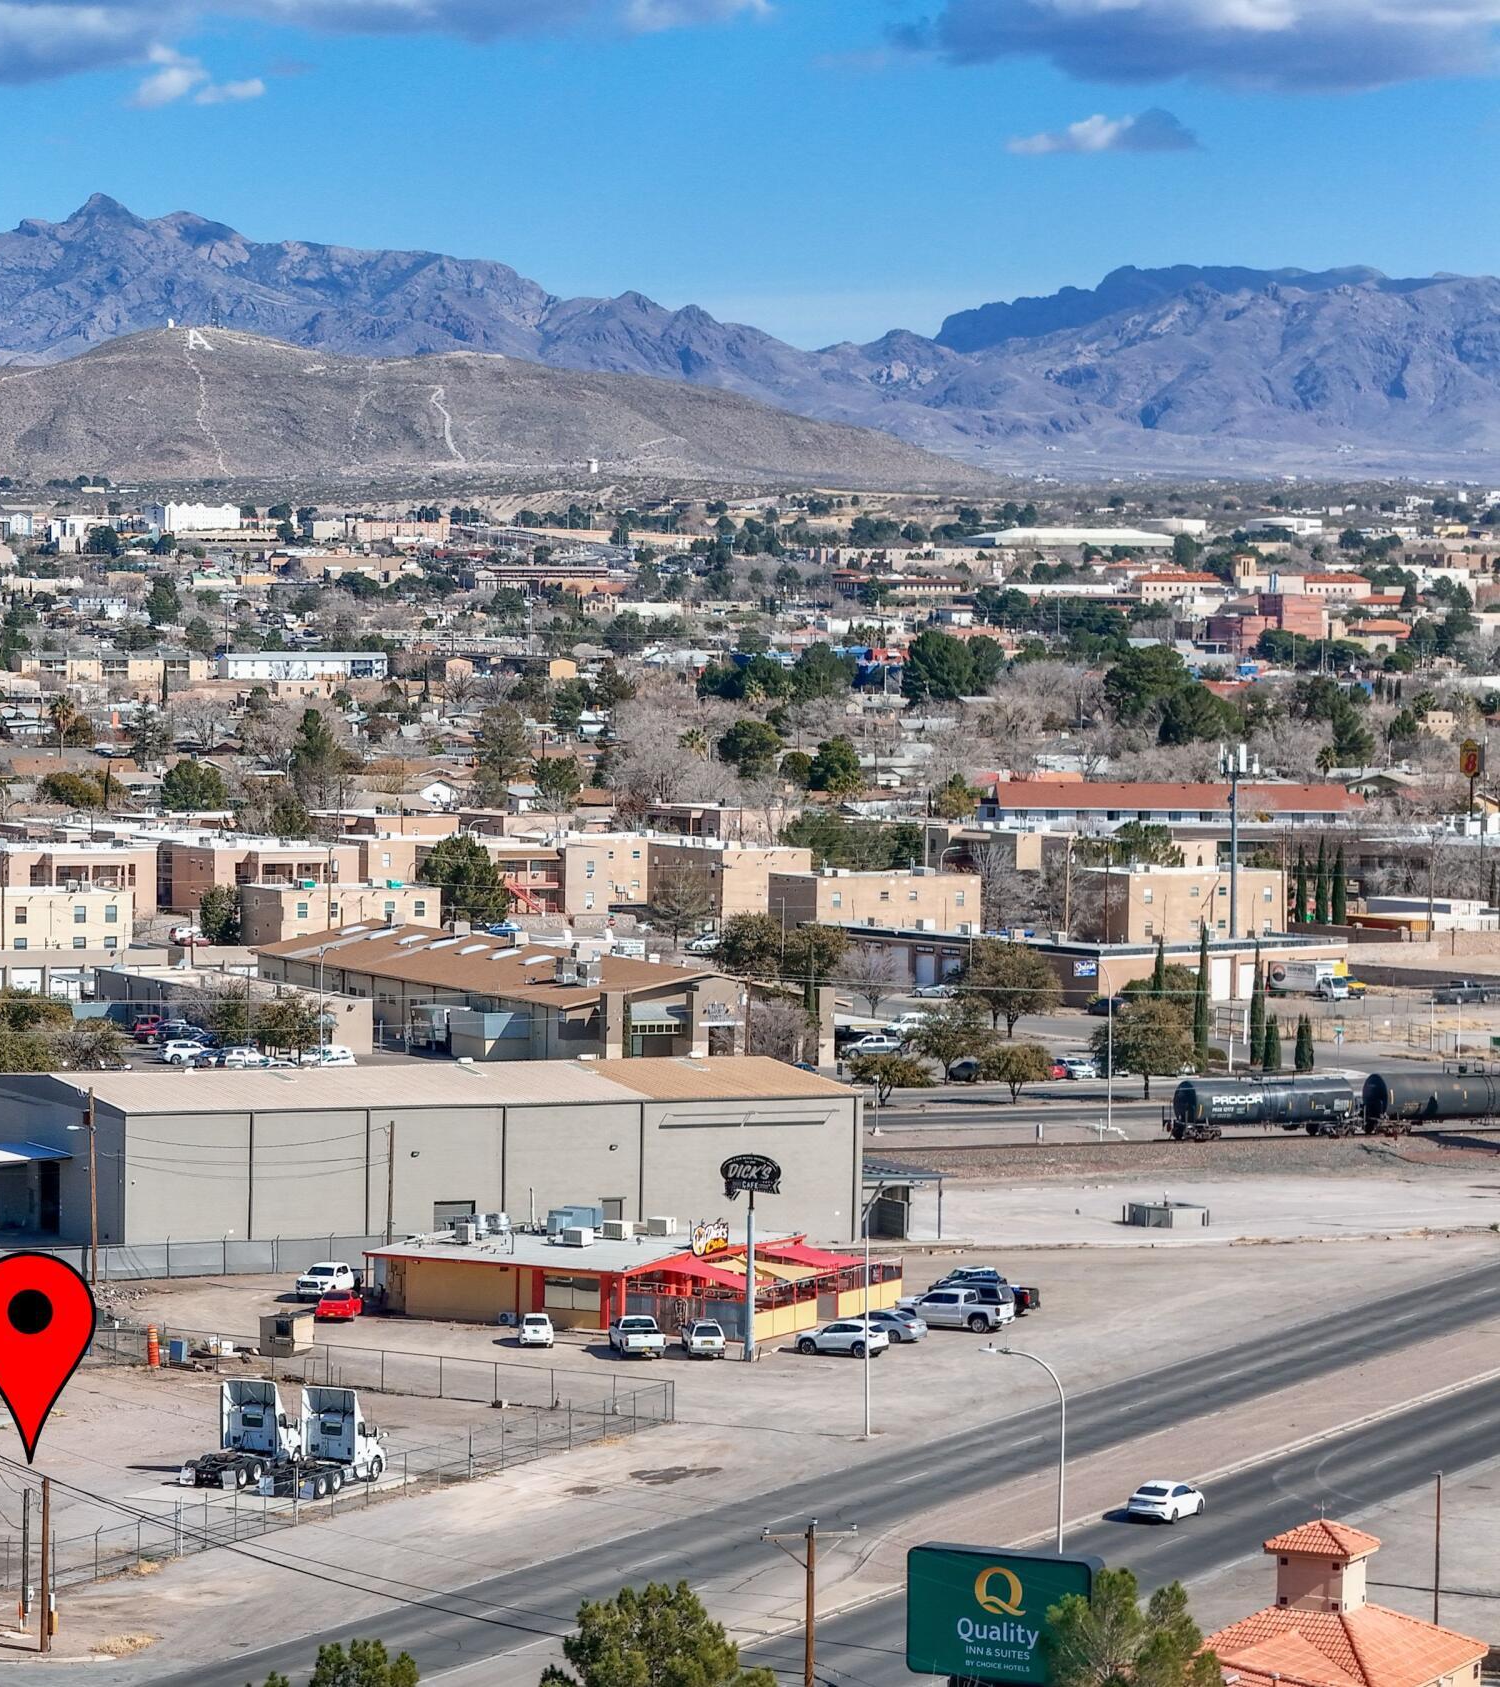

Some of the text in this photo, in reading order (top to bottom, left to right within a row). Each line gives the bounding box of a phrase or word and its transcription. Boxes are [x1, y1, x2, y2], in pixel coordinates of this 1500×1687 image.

[1212, 1094, 1263, 1106] PROCOR
[728, 1163, 772, 1180] DICK'S
[957, 1617, 1040, 1650] Quality
[965, 1645, 1030, 1660] INN & SUITES
[976, 1661, 1002, 1670] CHOICE
[1003, 1664, 1030, 1673] HOTELS
